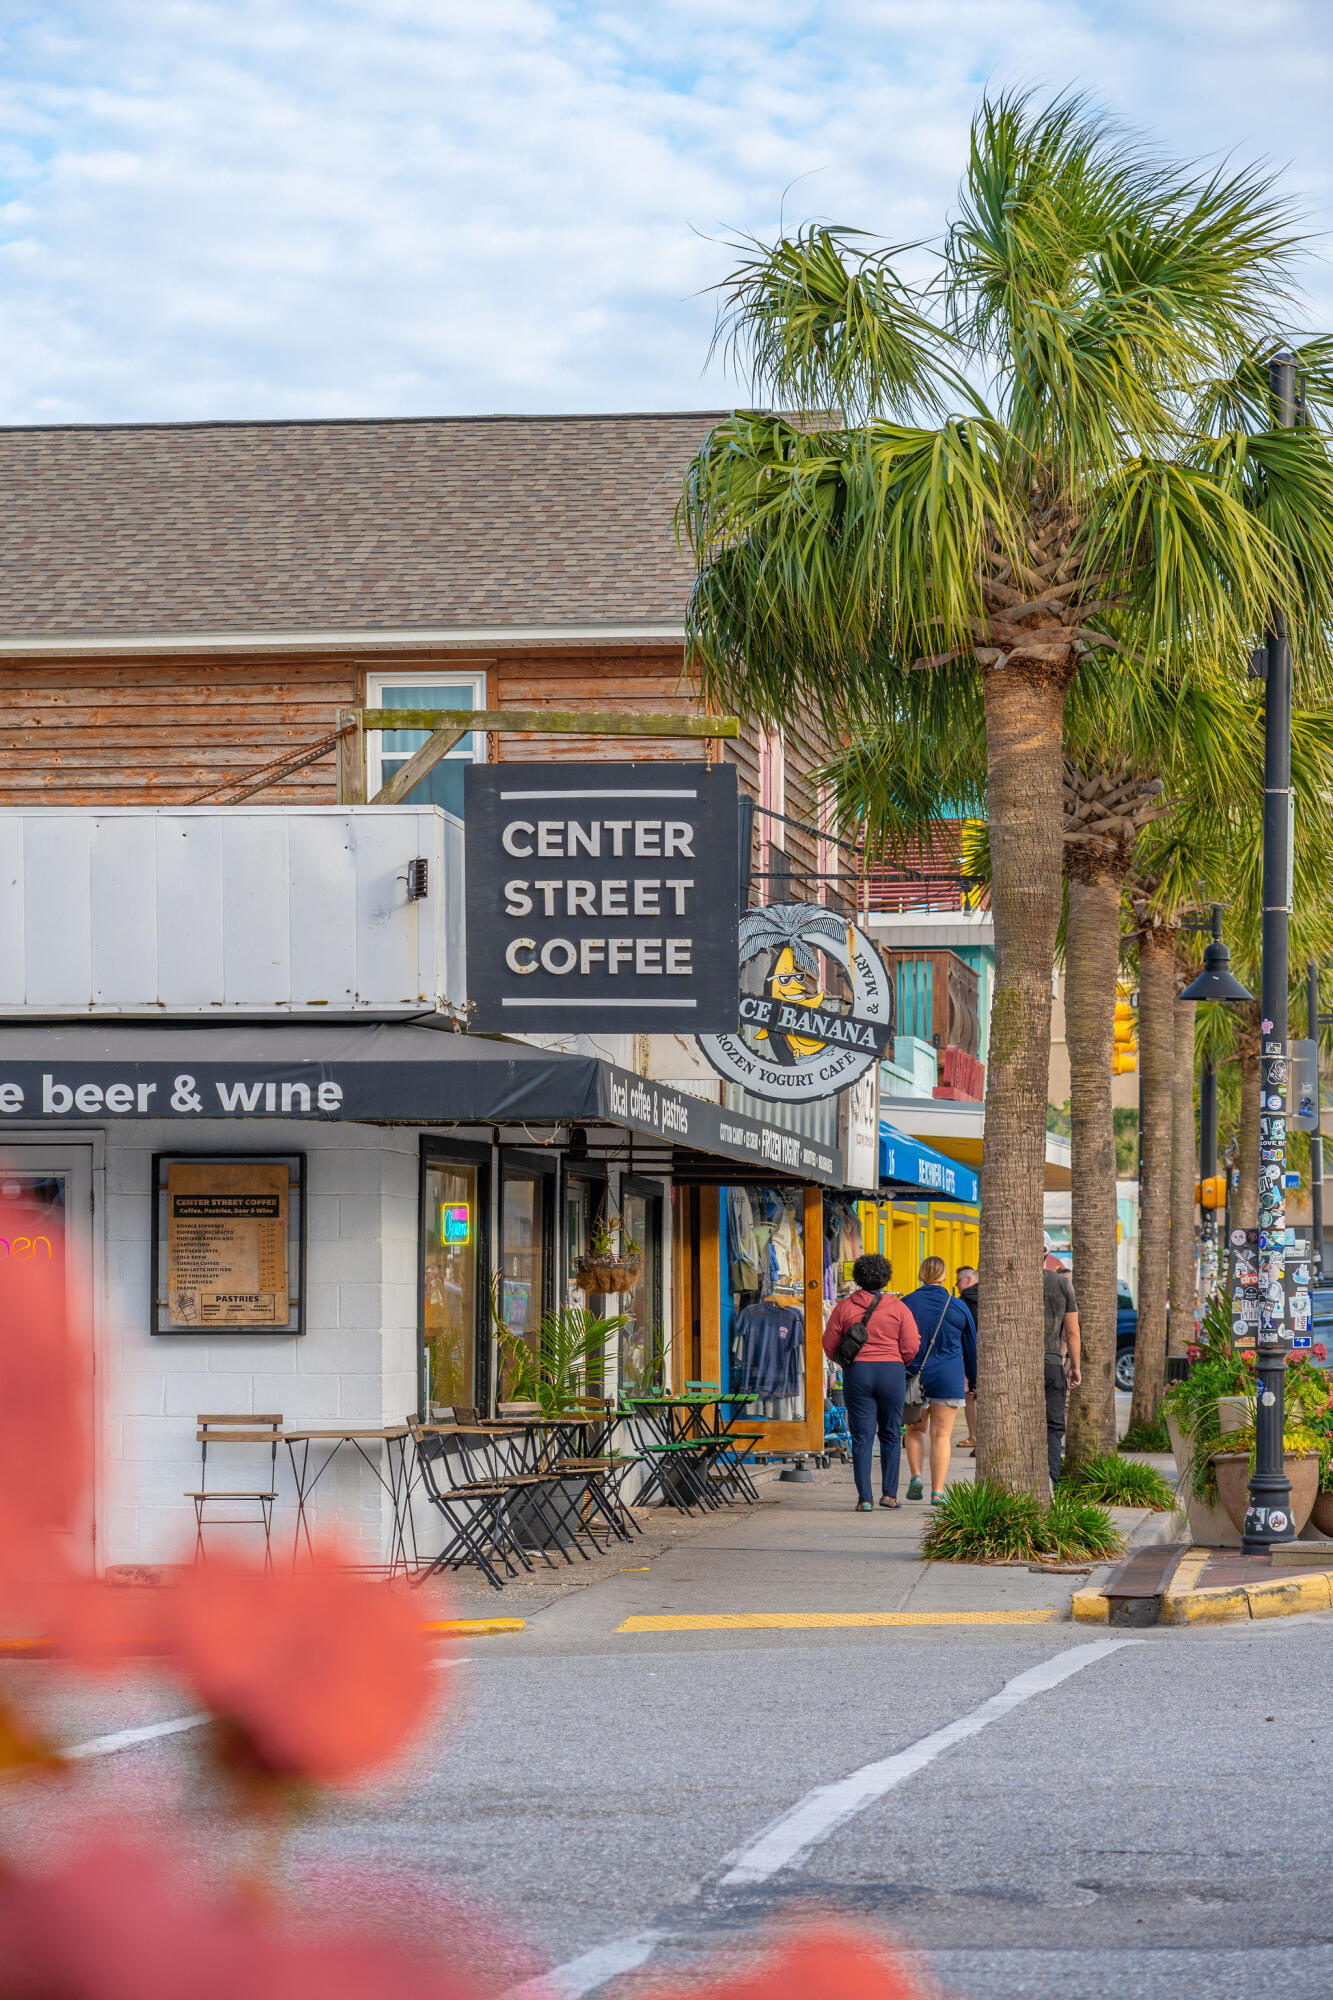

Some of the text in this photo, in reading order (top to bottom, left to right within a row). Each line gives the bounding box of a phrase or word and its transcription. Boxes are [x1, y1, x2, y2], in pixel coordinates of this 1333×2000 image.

[501, 820, 696, 859] CENTER
[503, 879, 695, 917] STREET
[505, 937, 693, 975] COFFEE
[716, 952, 879, 1087] ROZEN YOGURT CAFE & MART
[739, 998, 878, 1050] CE BANANA
[0, 1074, 344, 1113] e beer & wine
[610, 1072, 689, 1134] local coffee & pastries
[761, 1128, 781, 1163] FROZEN
[176, 1198, 277, 1206] CENTER STREET COFFEE
[445, 1210, 468, 1244] Open
[0, 1236, 52, 1261] en
[216, 1295, 260, 1303] PASTRIES
